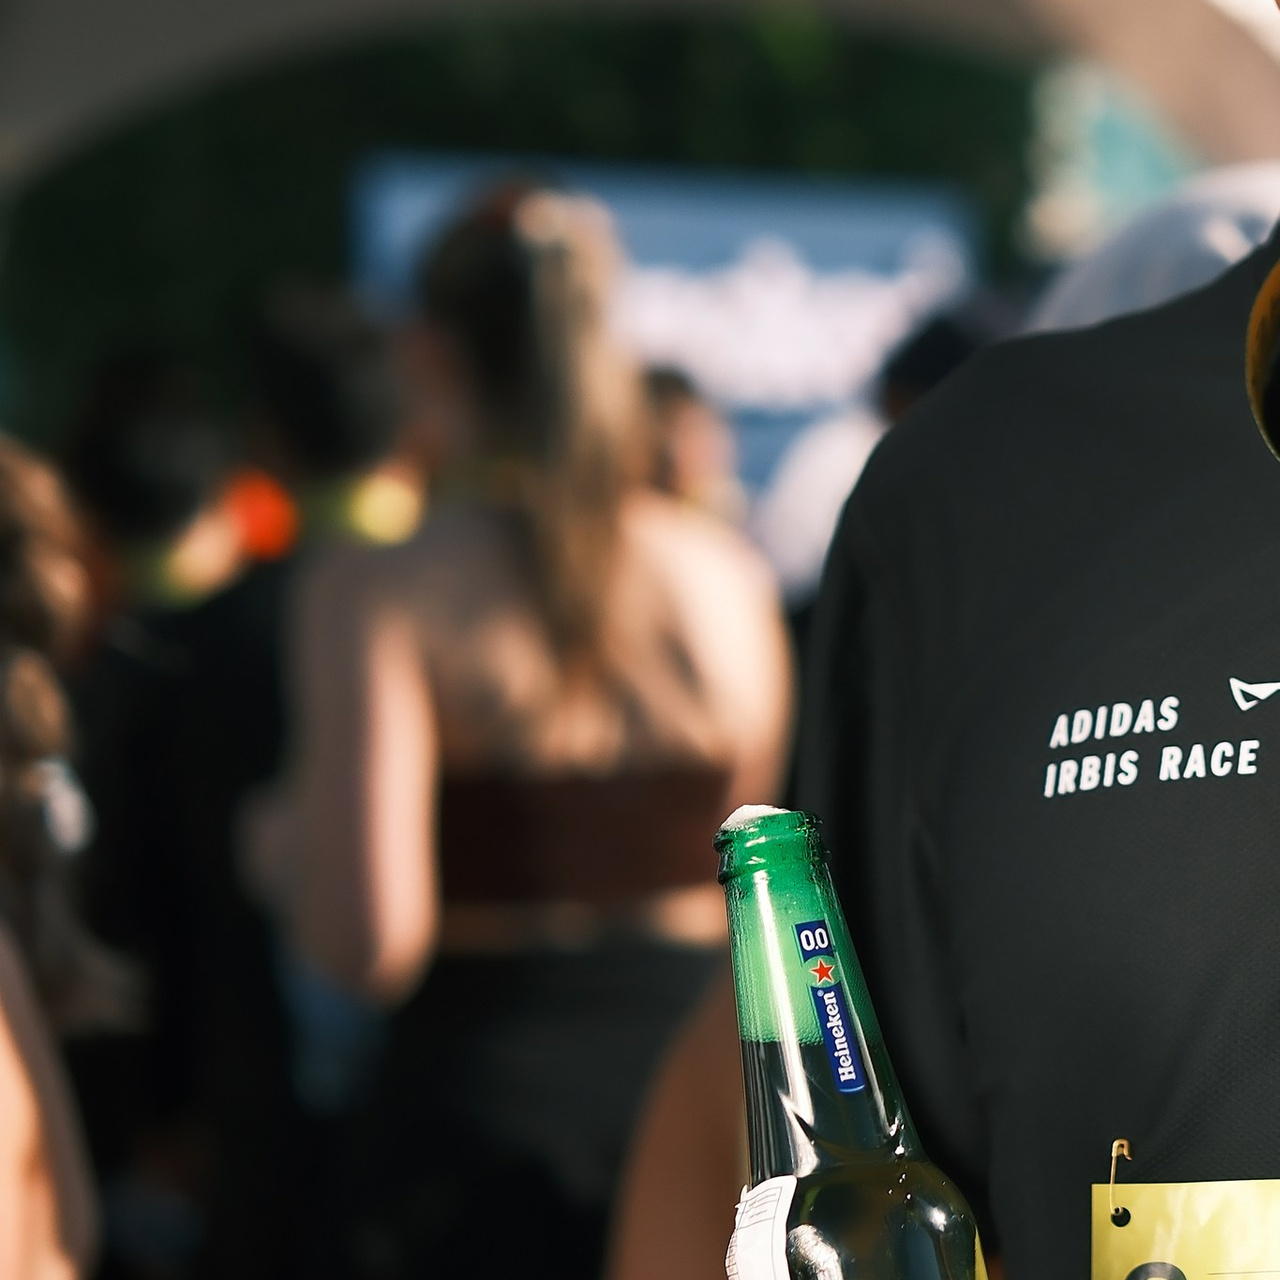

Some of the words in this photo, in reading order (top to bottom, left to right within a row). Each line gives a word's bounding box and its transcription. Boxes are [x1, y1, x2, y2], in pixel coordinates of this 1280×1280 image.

[1050, 696, 1180, 749] ADIDAS
[1044, 750, 1139, 798] IRBIS
[1159, 740, 1260, 781] RACE
[800, 927, 829, 951] 0.0
[825, 991, 857, 1082] Heineken
